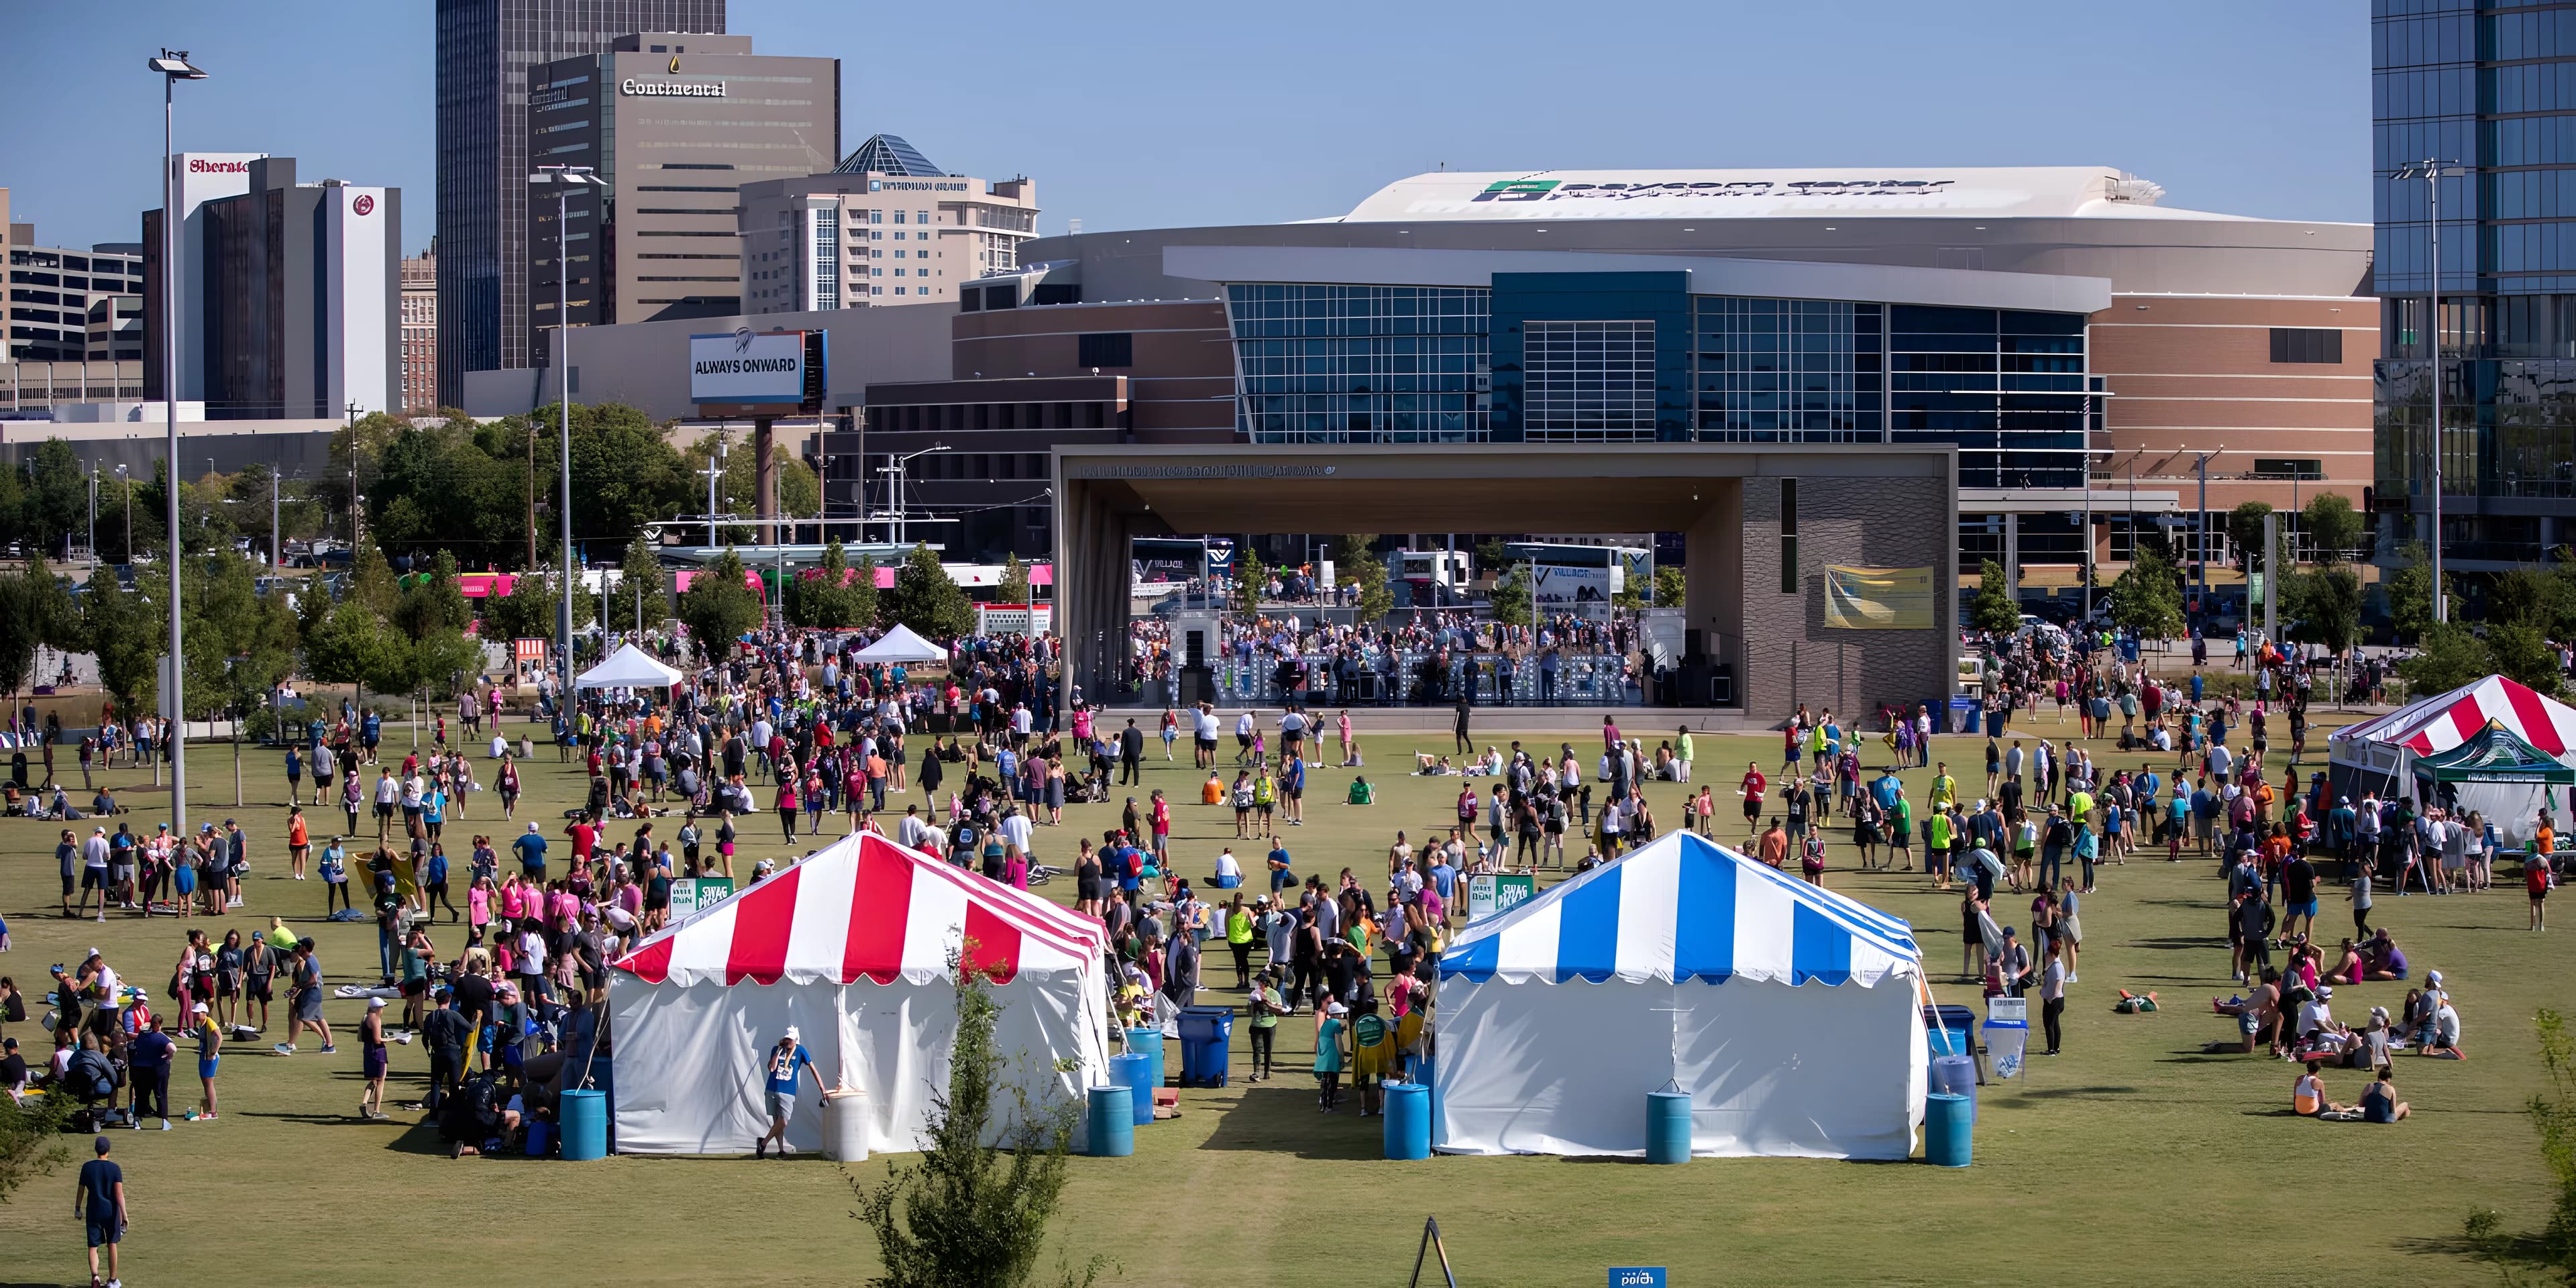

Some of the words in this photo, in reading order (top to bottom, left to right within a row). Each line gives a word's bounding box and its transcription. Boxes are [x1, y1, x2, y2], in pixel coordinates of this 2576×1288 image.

[623, 78, 727, 96] Continental
[695, 360, 740, 374] ALWAYS
[743, 358, 796, 373] ONWARD
